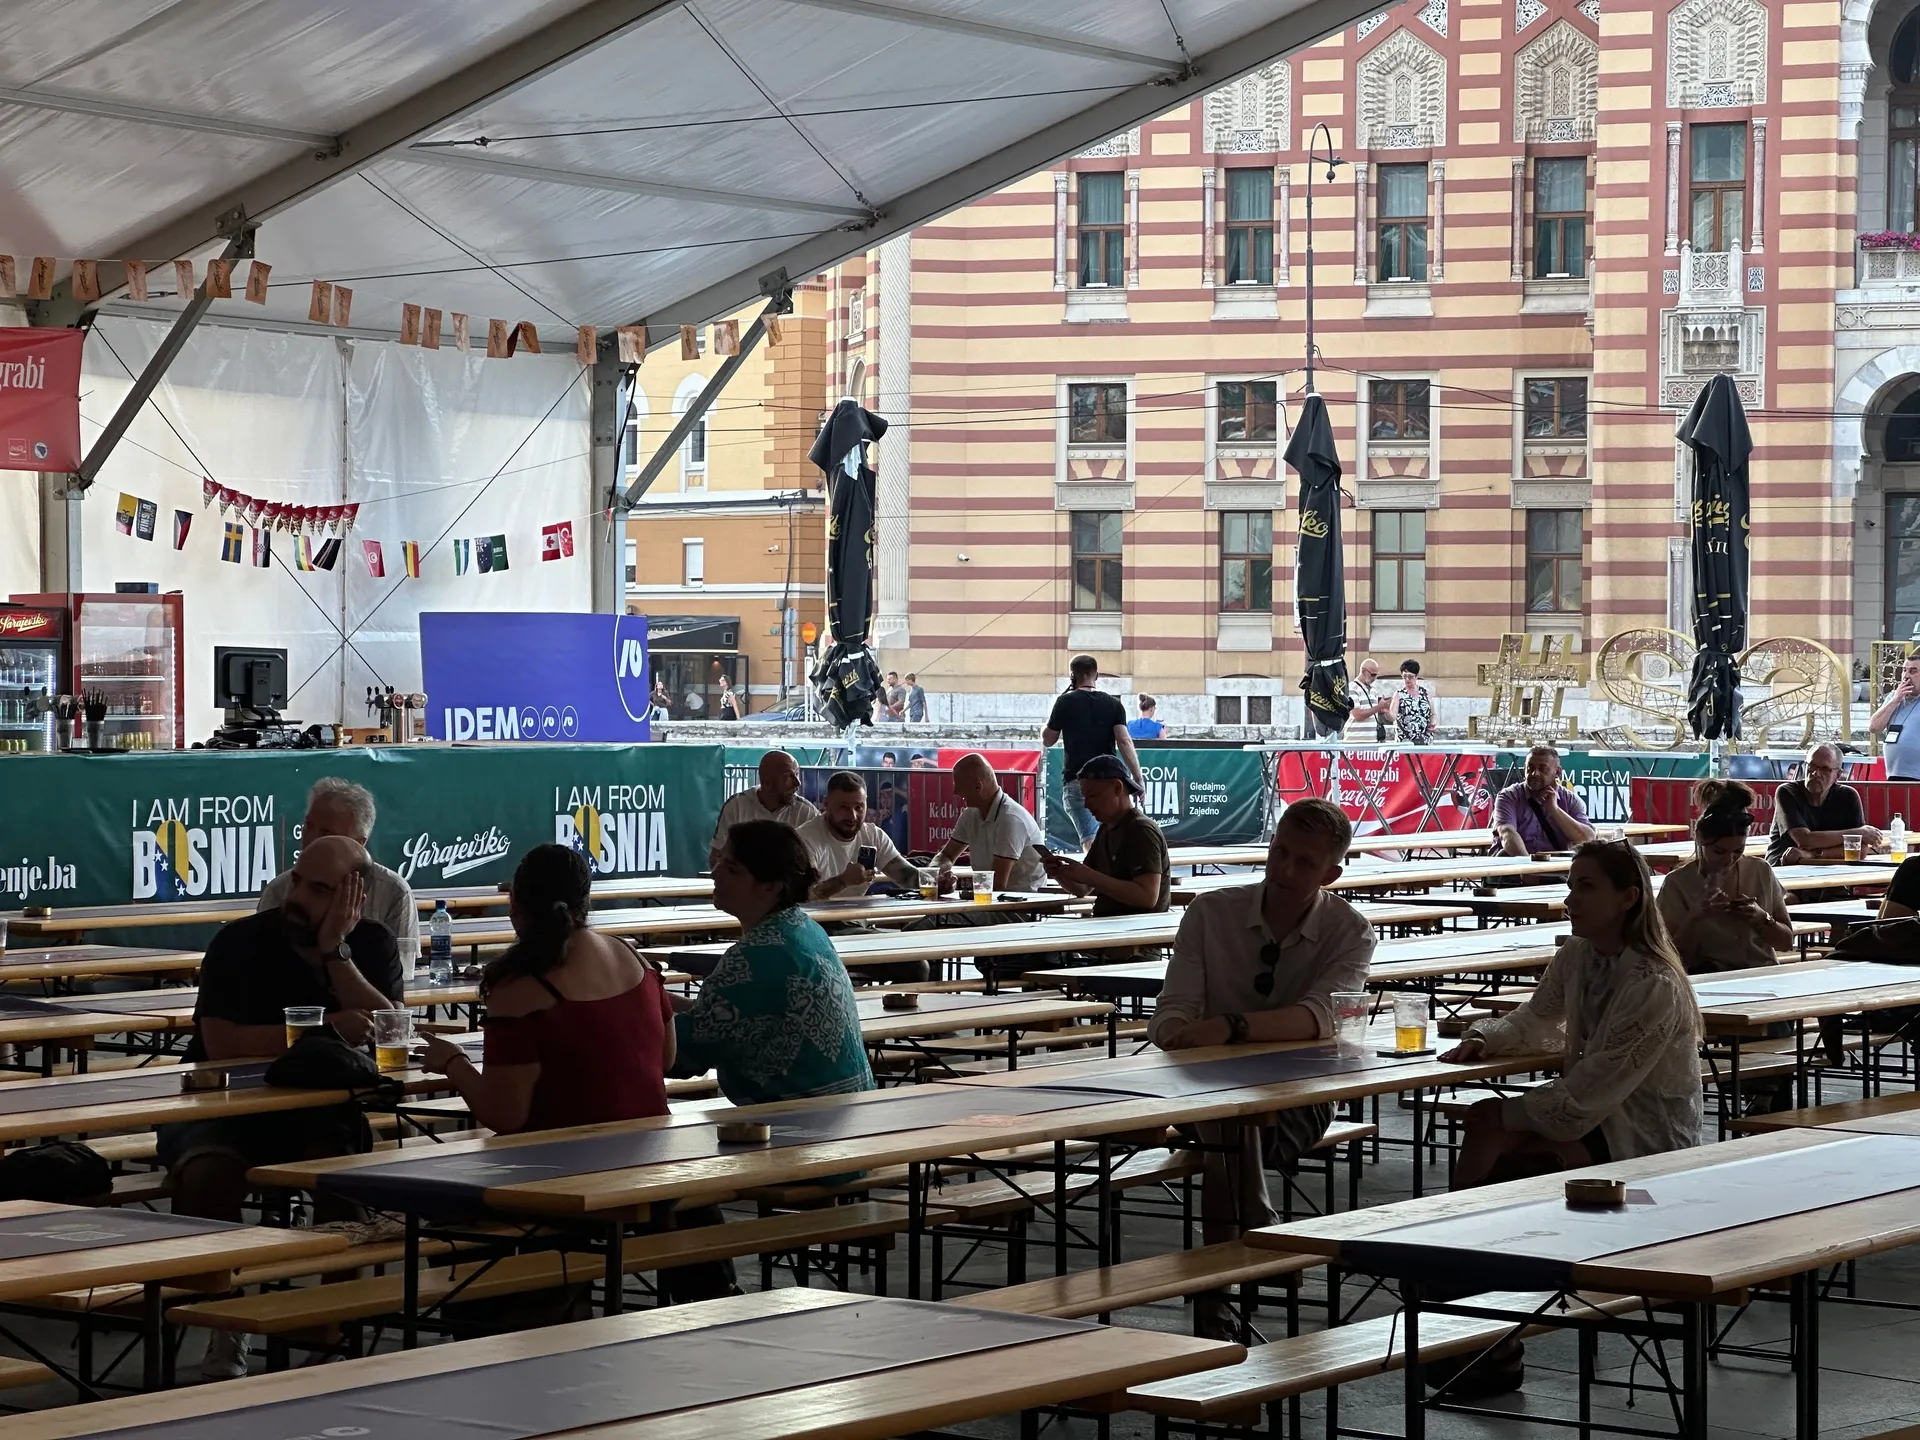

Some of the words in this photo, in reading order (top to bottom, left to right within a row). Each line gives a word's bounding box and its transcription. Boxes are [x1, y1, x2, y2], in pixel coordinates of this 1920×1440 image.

[555, 786, 560, 812] I
[566, 785, 602, 811] AM
[608, 784, 666, 811] FROM
[1189, 781, 1226, 793] Gledajmo
[1189, 794, 1228, 803] SVJETSKO
[132, 799, 138, 828] I
[146, 797, 190, 827] AM
[199, 794, 275, 825] FROM
[1189, 806, 1220, 817] Zajedno
[132, 819, 277, 901] BOSNIA
[398, 825, 512, 881] Sarajevsko
